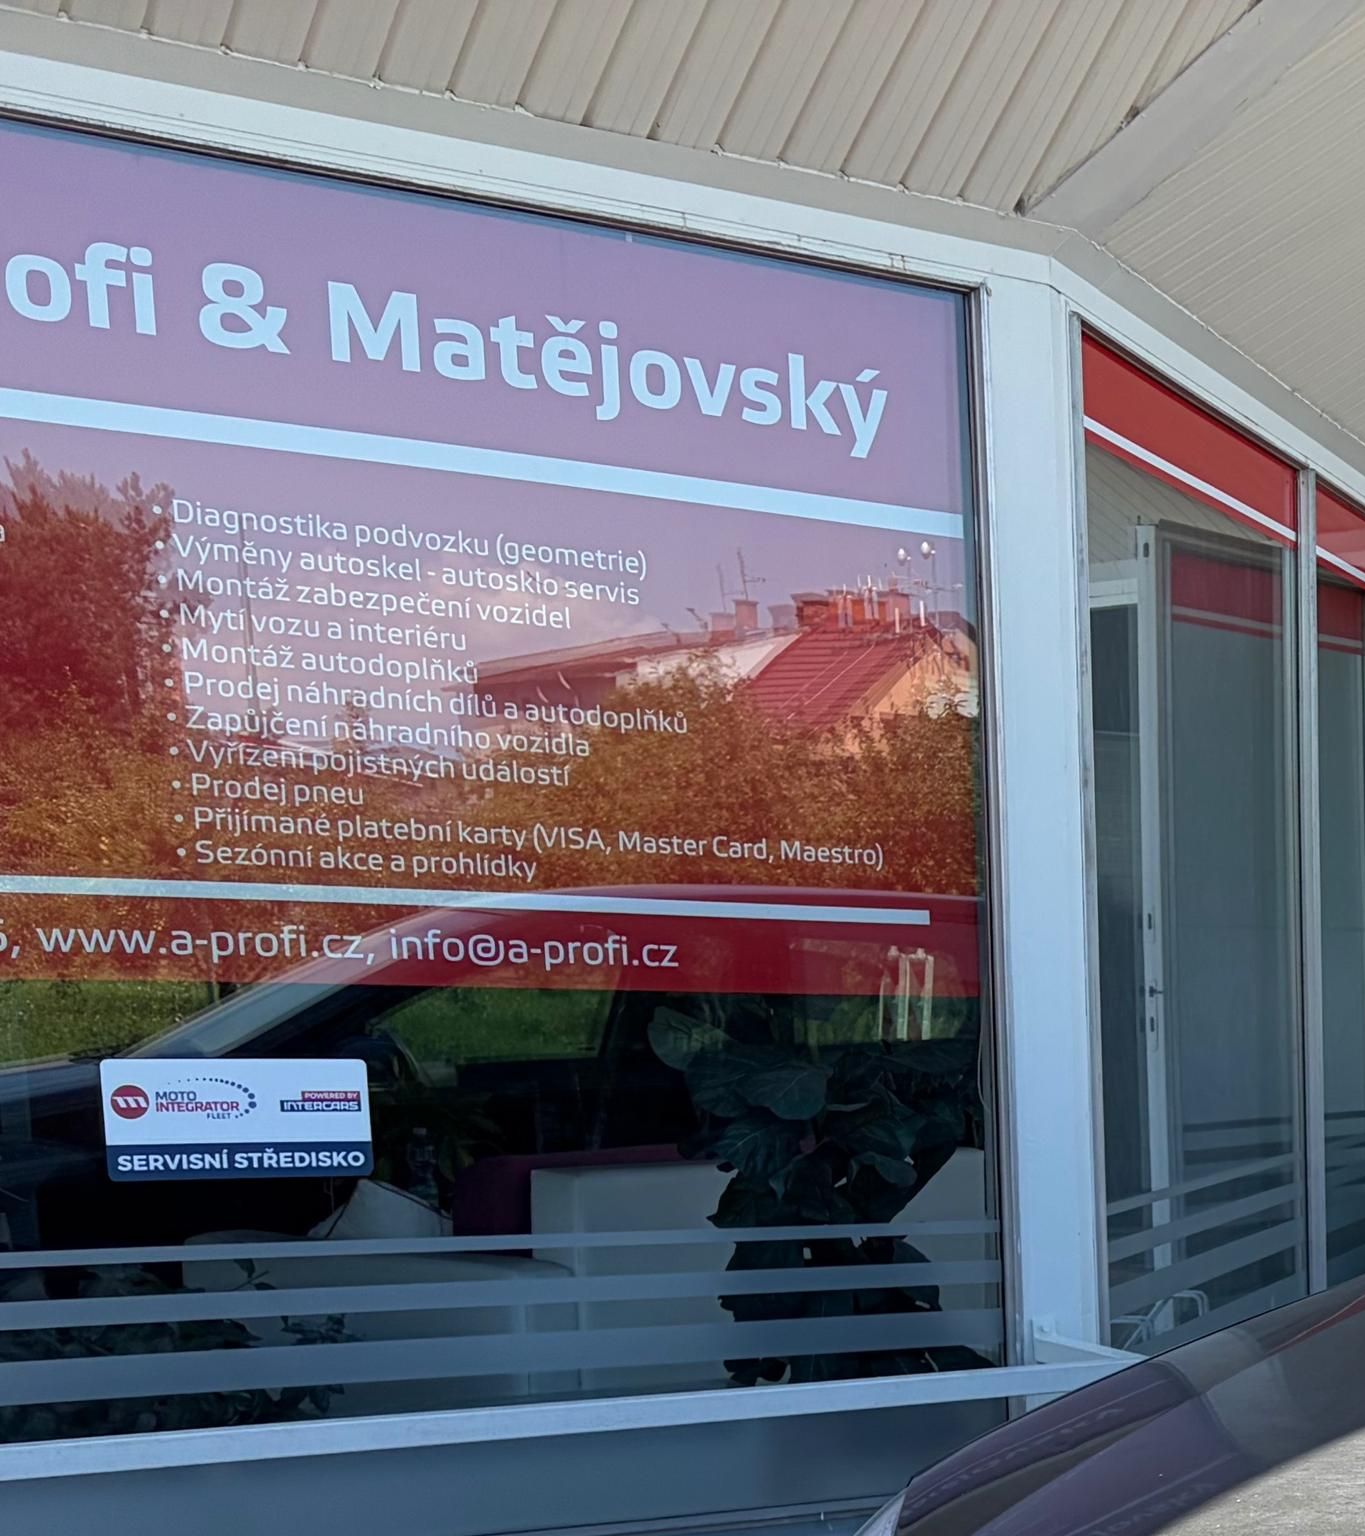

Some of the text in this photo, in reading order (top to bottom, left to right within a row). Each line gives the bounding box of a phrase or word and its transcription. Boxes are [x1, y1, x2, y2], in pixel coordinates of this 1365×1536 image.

[199, 262, 291, 355] &
[327, 280, 888, 459] Matějovský
[172, 499, 648, 581] Diagnostika podvozku (geometrie)
[172, 534, 292, 573] Výměny
[300, 550, 422, 583] autoskel
[441, 563, 558, 597] autosklo
[564, 575, 640, 605] servis
[176, 568, 572, 630] Montáž zabezpečení vozidel
[178, 602, 467, 652] Mytí vozu a interiéru
[181, 636, 478, 687] Montáž autodoplňků
[184, 671, 688, 736] Prodej náhradních dílů a autodoplňků
[185, 706, 591, 758] Zapůjčení náhradního vozidla
[187, 739, 570, 787] Vyřízení pojistných událostí
[191, 773, 364, 807] Prodej pneu
[194, 806, 884, 872] Přijímané platební karty (VISA, Master Card, Maestro)
[196, 840, 536, 884] Sezónní akce a prohlídky
[36, 924, 376, 965] www.a-profi.cz,
[390, 929, 679, 971] info@a-profi.cz
[155, 1091, 197, 1101] MOTO
[155, 1101, 240, 1112] INTEGRATOR
[304, 1091, 358, 1100] POWERED BY
[117, 1148, 365, 1172] SERVISNÍ STŘEDISKO
